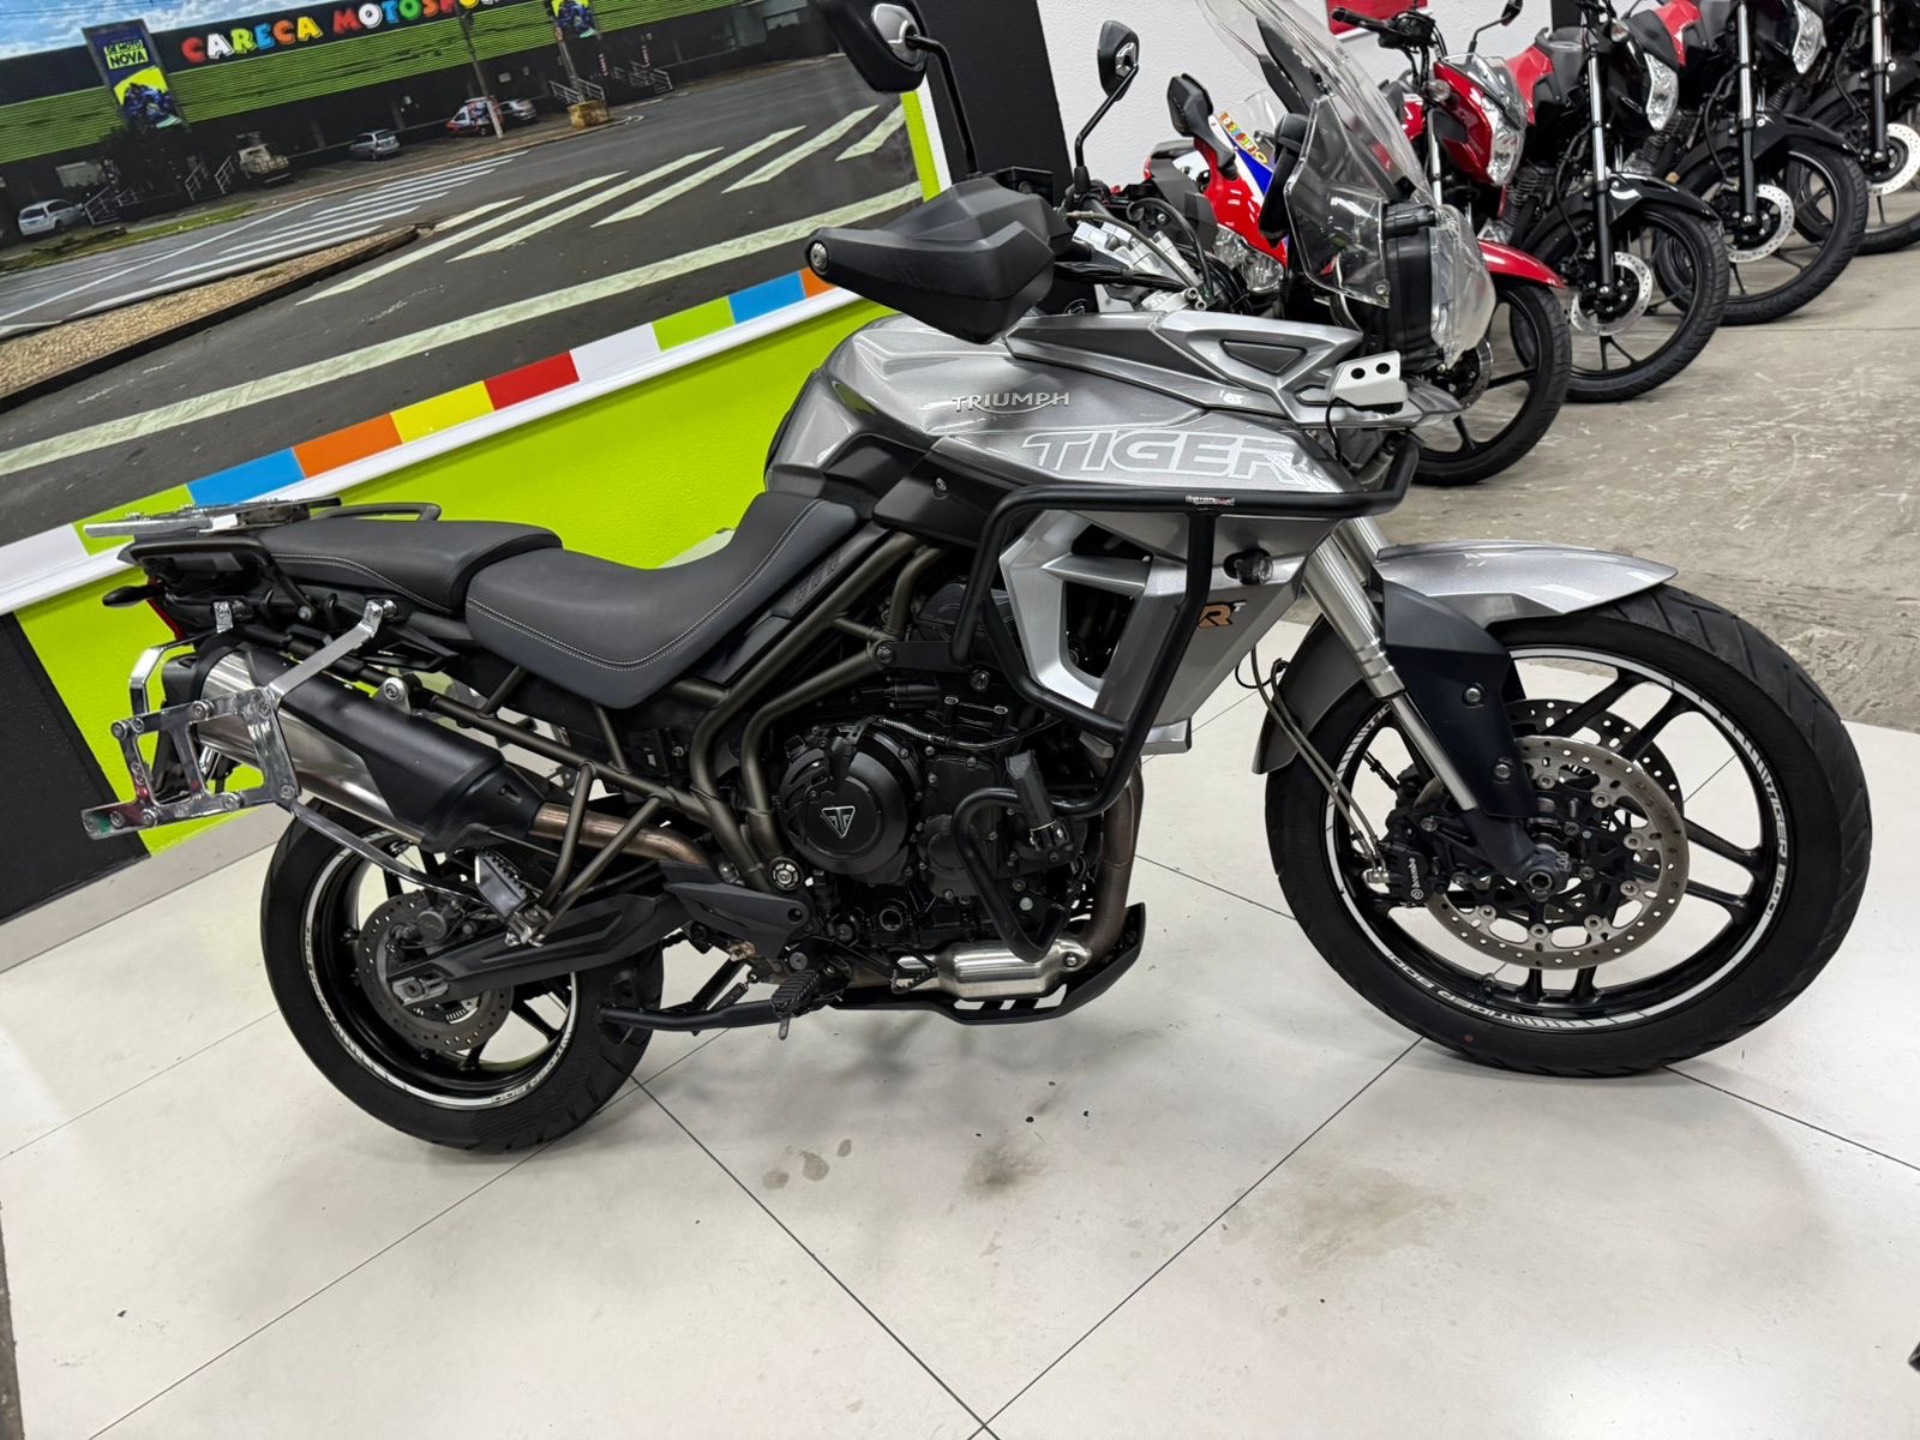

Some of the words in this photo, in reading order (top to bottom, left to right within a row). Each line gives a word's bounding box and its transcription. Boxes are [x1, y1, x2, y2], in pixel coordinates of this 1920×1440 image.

[182, 16, 324, 62] CARECA
[108, 50, 146, 68] NOVA
[952, 391, 1070, 413] TRIUMPH
[1021, 429, 1308, 486] TIGER
